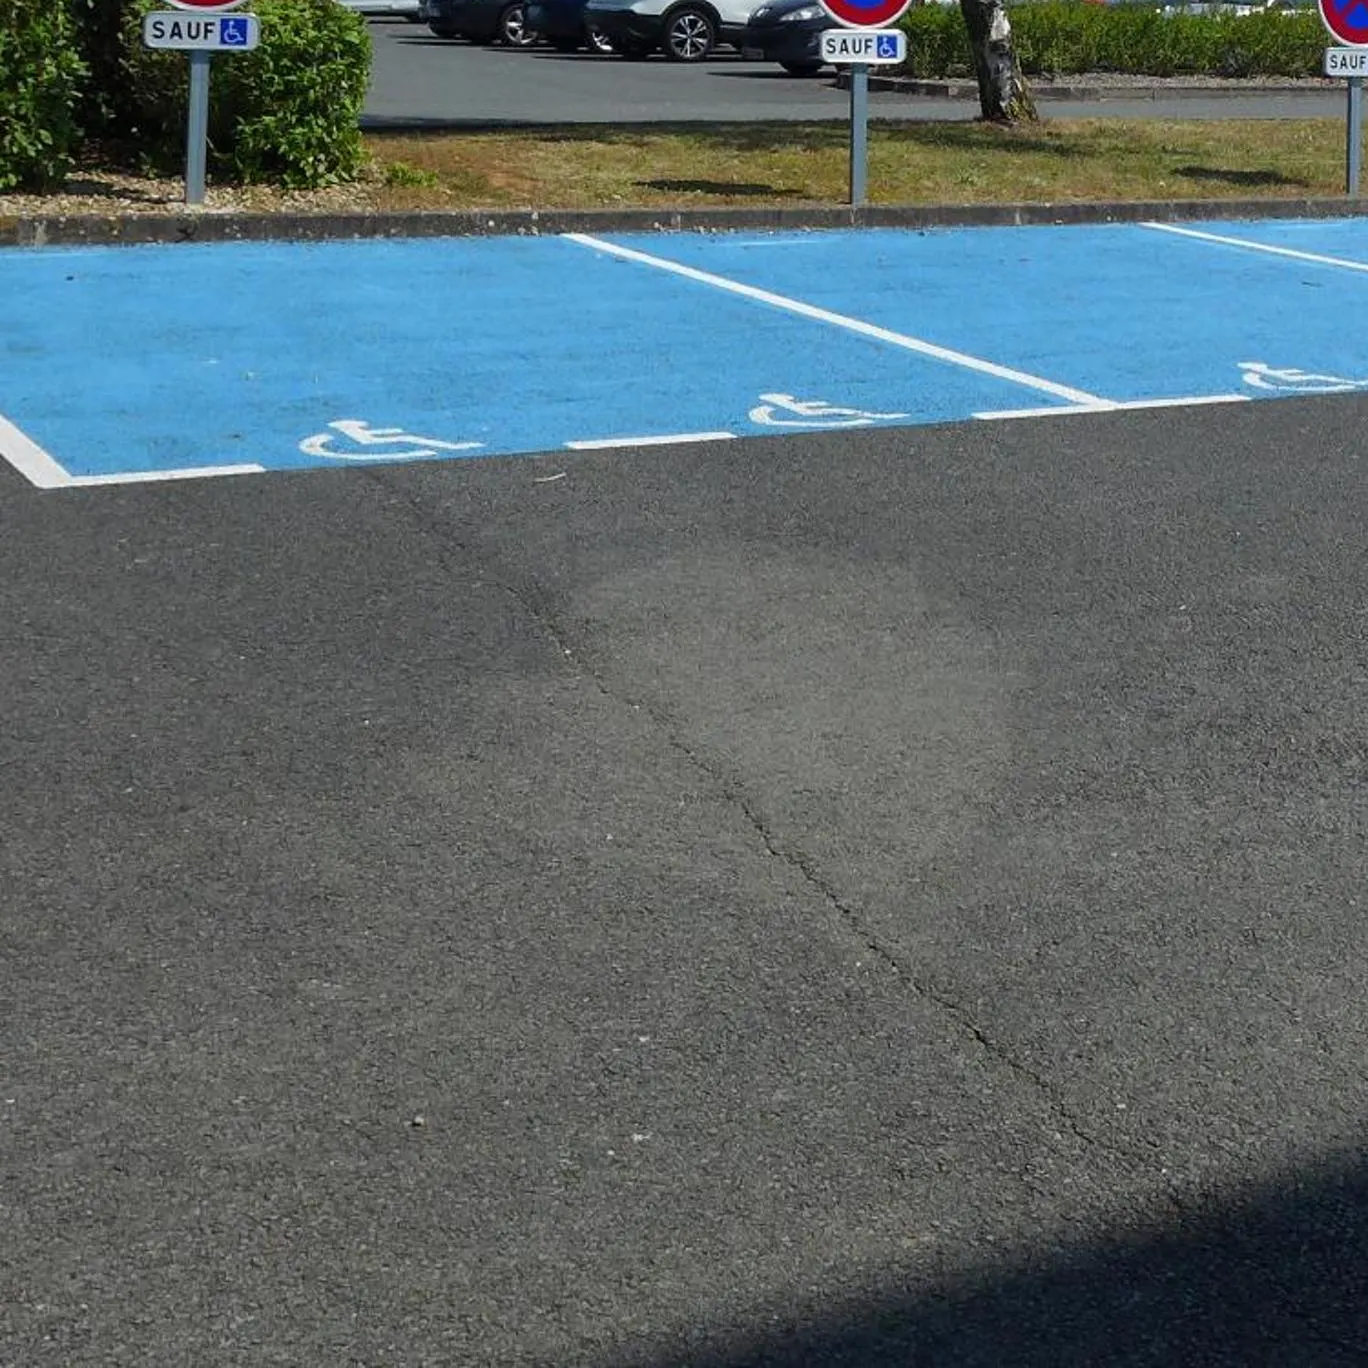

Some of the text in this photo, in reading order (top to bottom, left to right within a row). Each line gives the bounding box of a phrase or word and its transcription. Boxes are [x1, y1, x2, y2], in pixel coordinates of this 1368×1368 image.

[152, 20, 216, 41] SAUF
[826, 37, 873, 54] SAUF
[1330, 54, 1366, 69] SAUF
